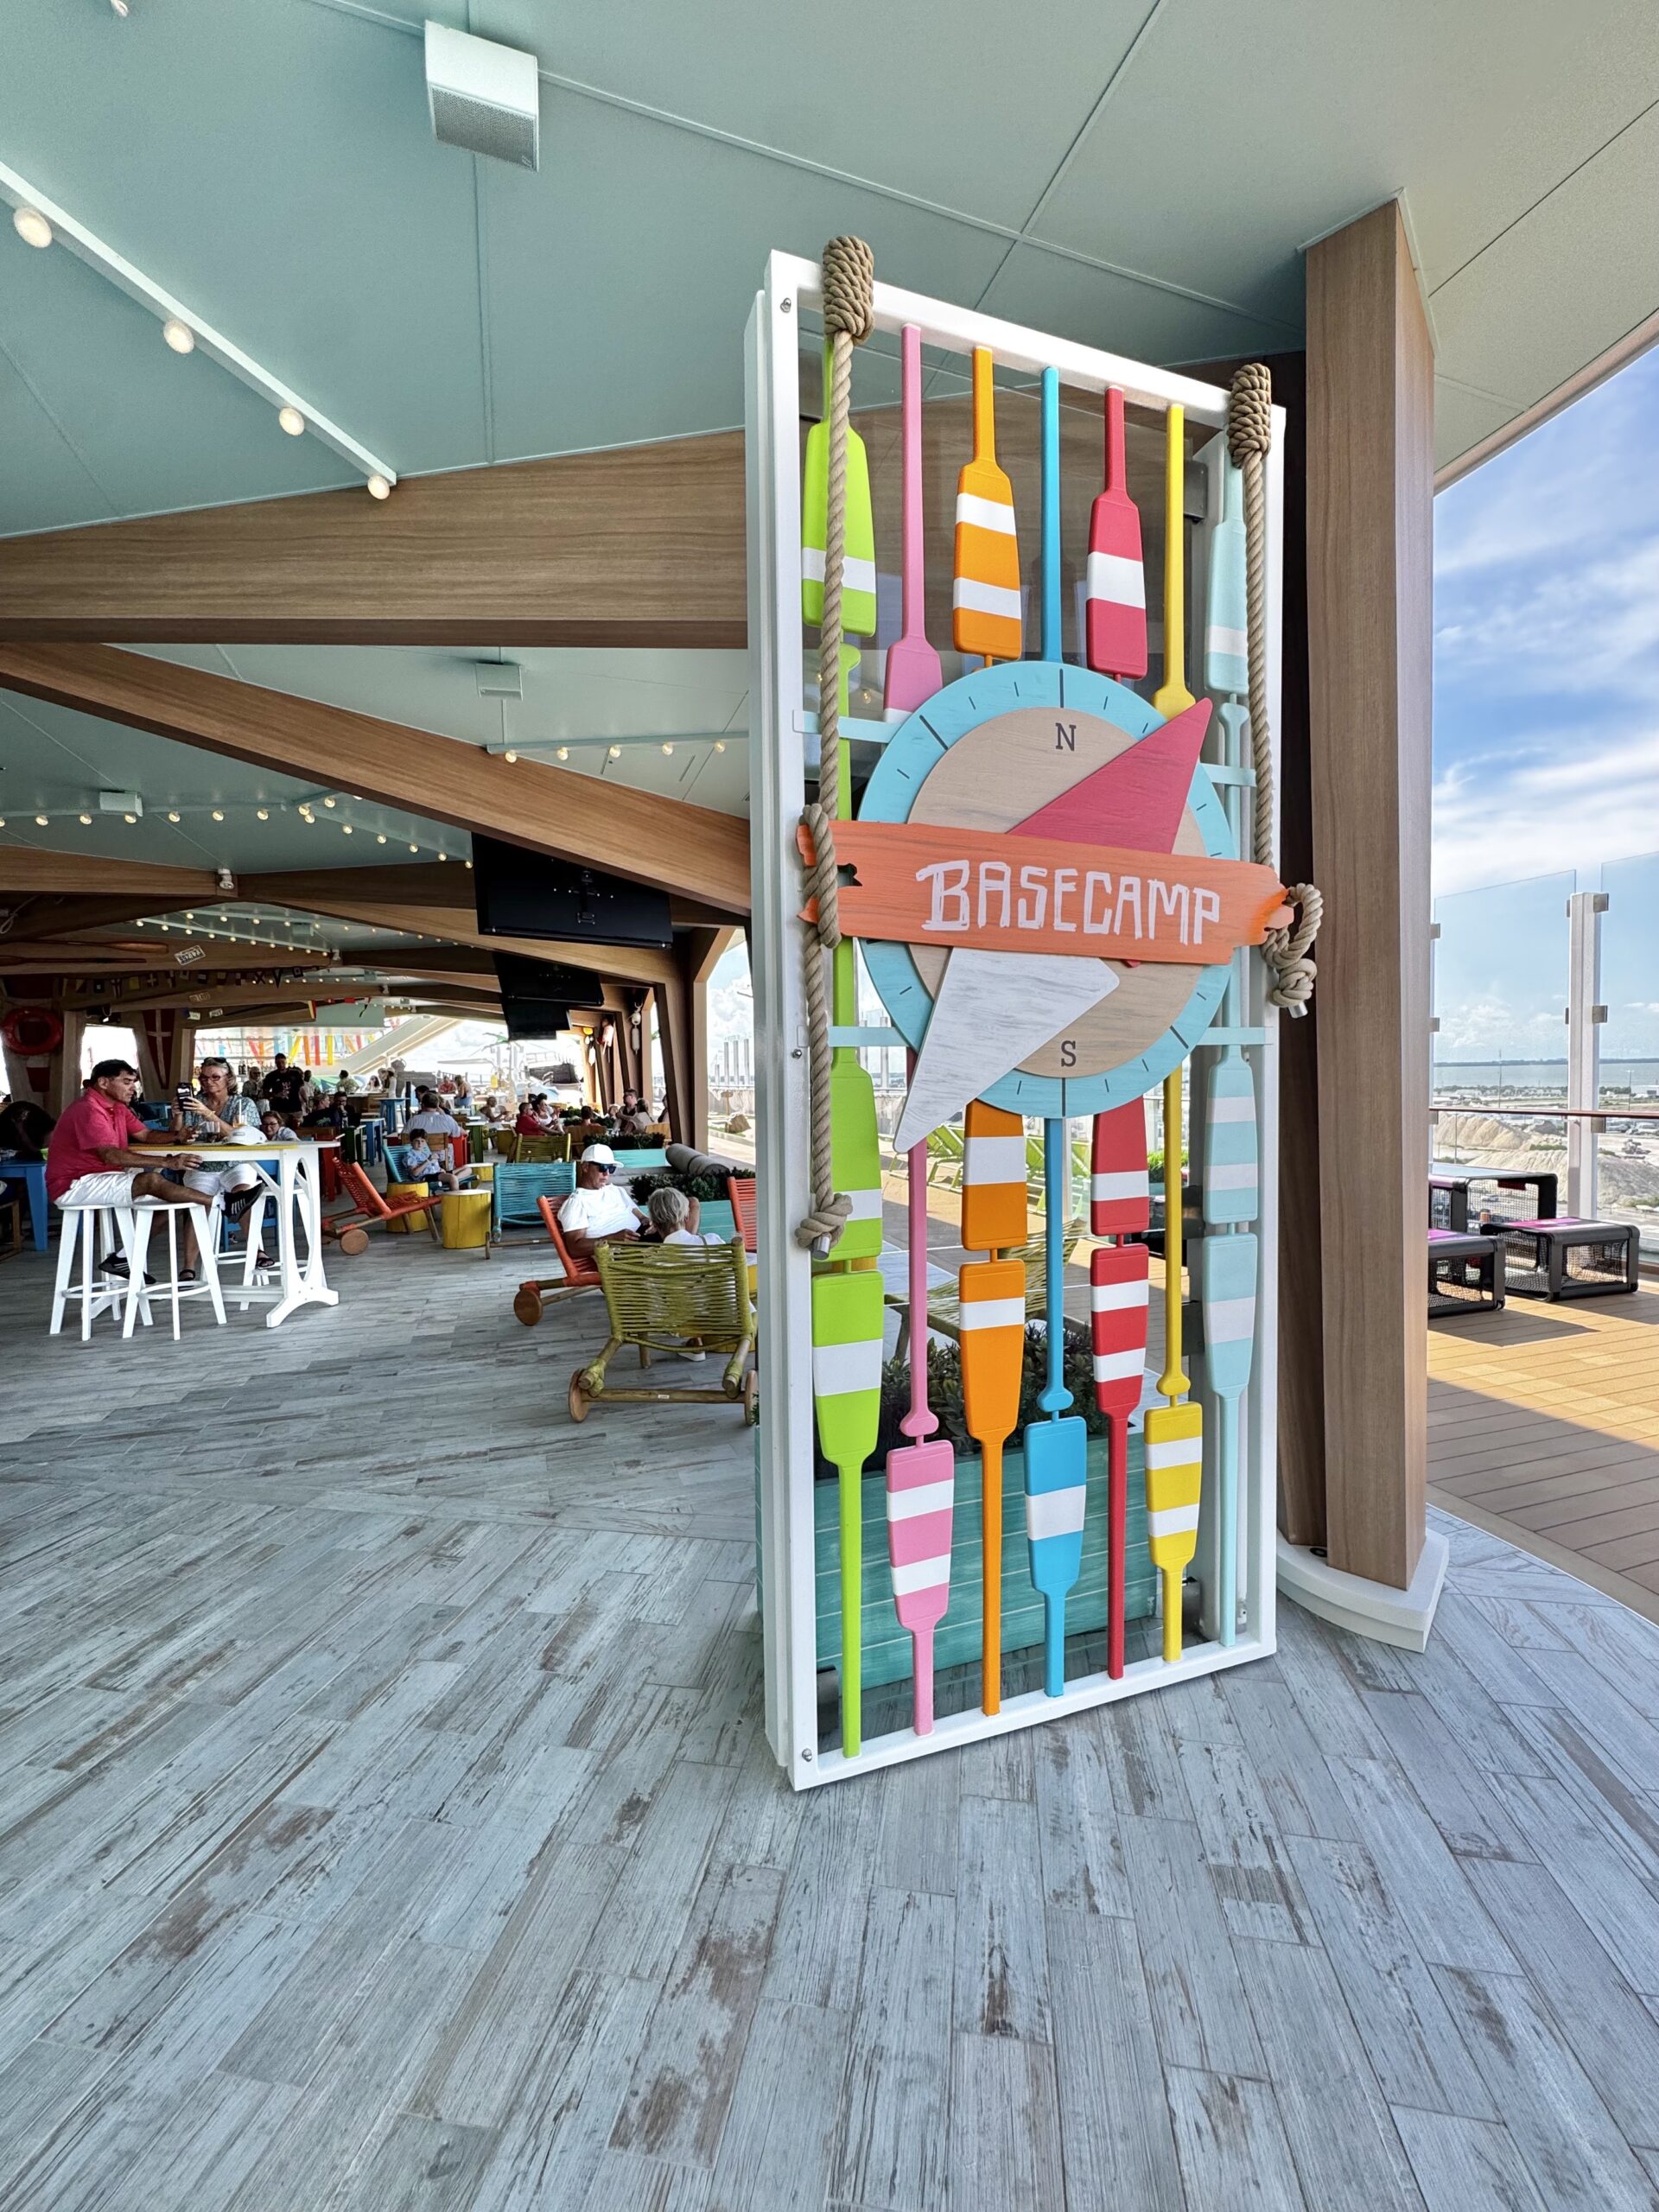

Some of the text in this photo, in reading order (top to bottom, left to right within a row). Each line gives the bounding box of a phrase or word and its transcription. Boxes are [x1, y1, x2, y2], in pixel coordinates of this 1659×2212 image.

[1056, 723, 1077, 751] N
[916, 860, 1220, 945] BASECAMP
[1060, 1040, 1077, 1067] S
